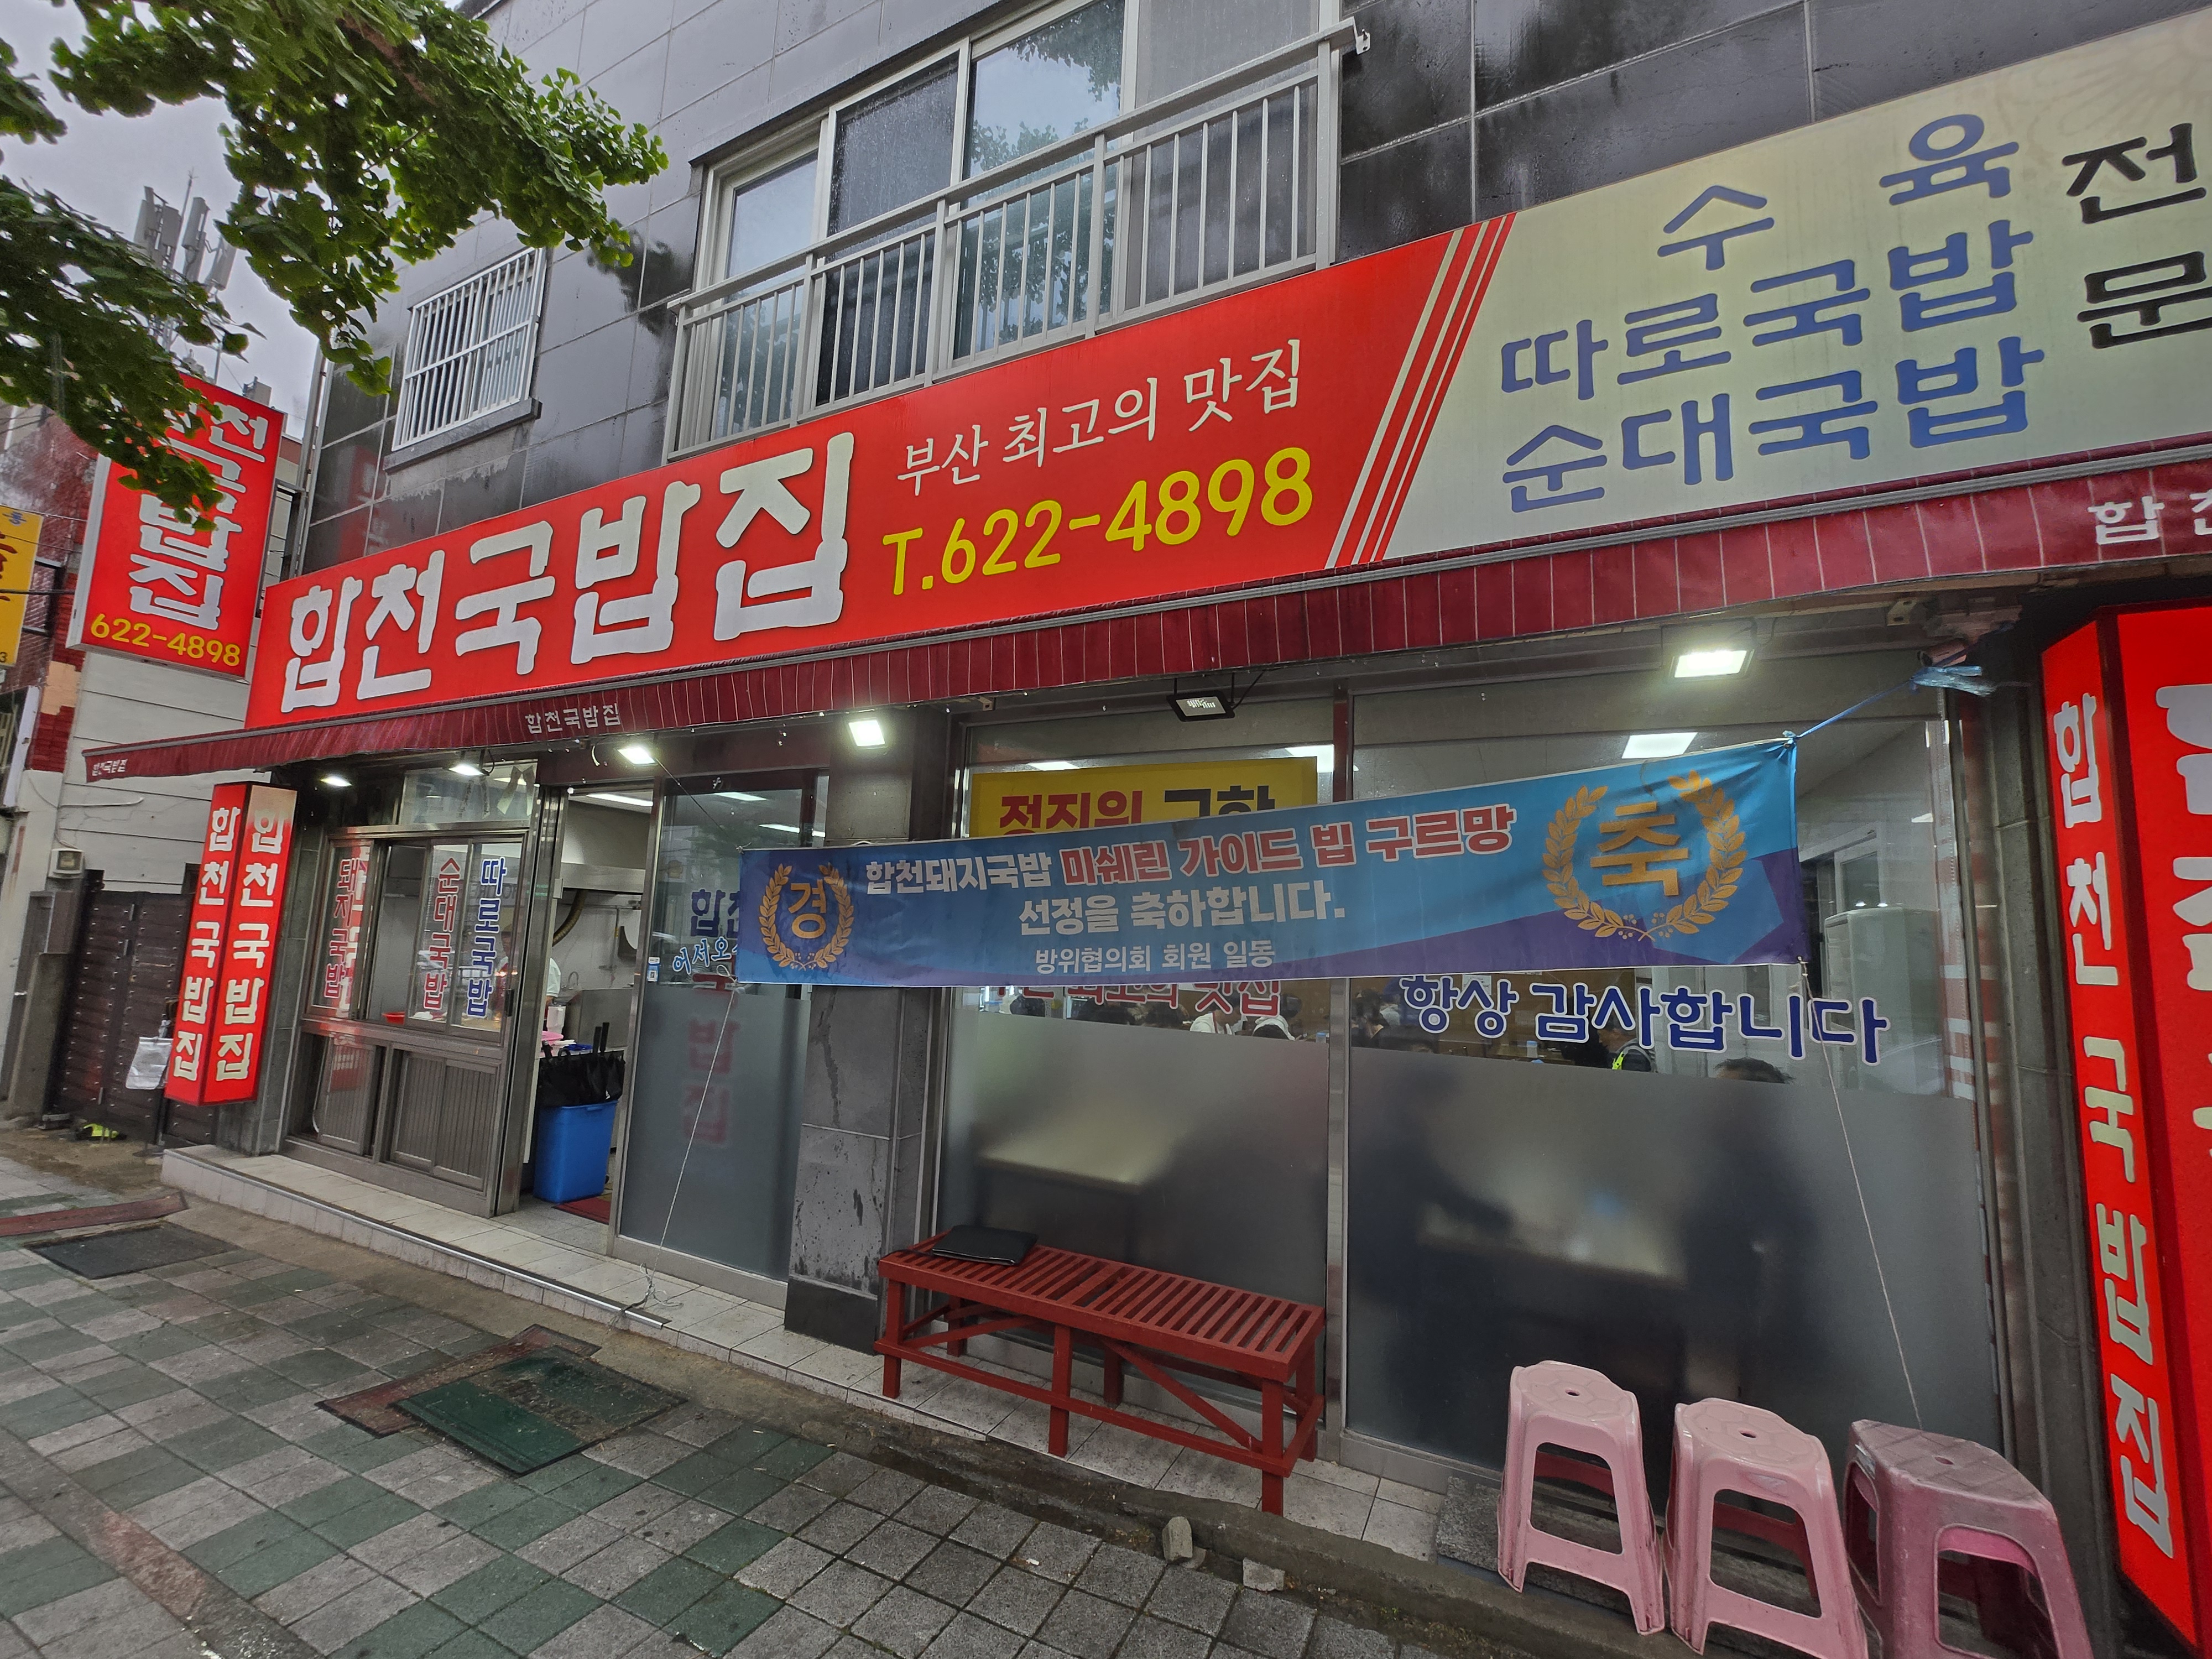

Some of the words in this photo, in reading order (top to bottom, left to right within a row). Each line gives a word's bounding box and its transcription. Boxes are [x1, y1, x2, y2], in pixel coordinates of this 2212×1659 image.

[1501, 220, 2033, 401] 따로국밥
[898, 424, 989, 497] 부산
[1003, 377, 1157, 468] 최고의
[1183, 339, 1301, 432] 맛집
[1503, 336, 2044, 513] 순대국밥
[90, 613, 241, 667] 622-4898
[280, 432, 855, 713] 합천국밥집
[525, 703, 621, 734] 합천국밥집
[787, 879, 828, 940] 경
[866, 852, 1052, 895] 합천돼지국밥
[1060, 840, 1173, 885] 미쉐린
[1177, 827, 1304, 878] 가이드
[1310, 821, 1357, 868] 빕
[1366, 804, 1517, 863] 구르망
[1019, 894, 1120, 936] 선정을
[1130, 880, 1345, 930] 축하합니다.
[1590, 801, 1689, 896] 축
[173, 807, 241, 1082] 합천국밥집
[216, 807, 290, 1082] 합천국밥집
[324, 858, 359, 999] 돼지국밥
[424, 857, 461, 1010] 순대국밥
[467, 857, 507, 1018] 따로국밥
[672, 936, 738, 975] 어서오
[1035, 944, 1151, 975] 방위협의회
[1162, 942, 1212, 971] 회원
[1223, 940, 1276, 968] 일동
[1399, 975, 1520, 1039] 항상
[1530, 982, 1891, 1066] 감사합니다
[2053, 693, 2173, 1558] 합천국밥집
